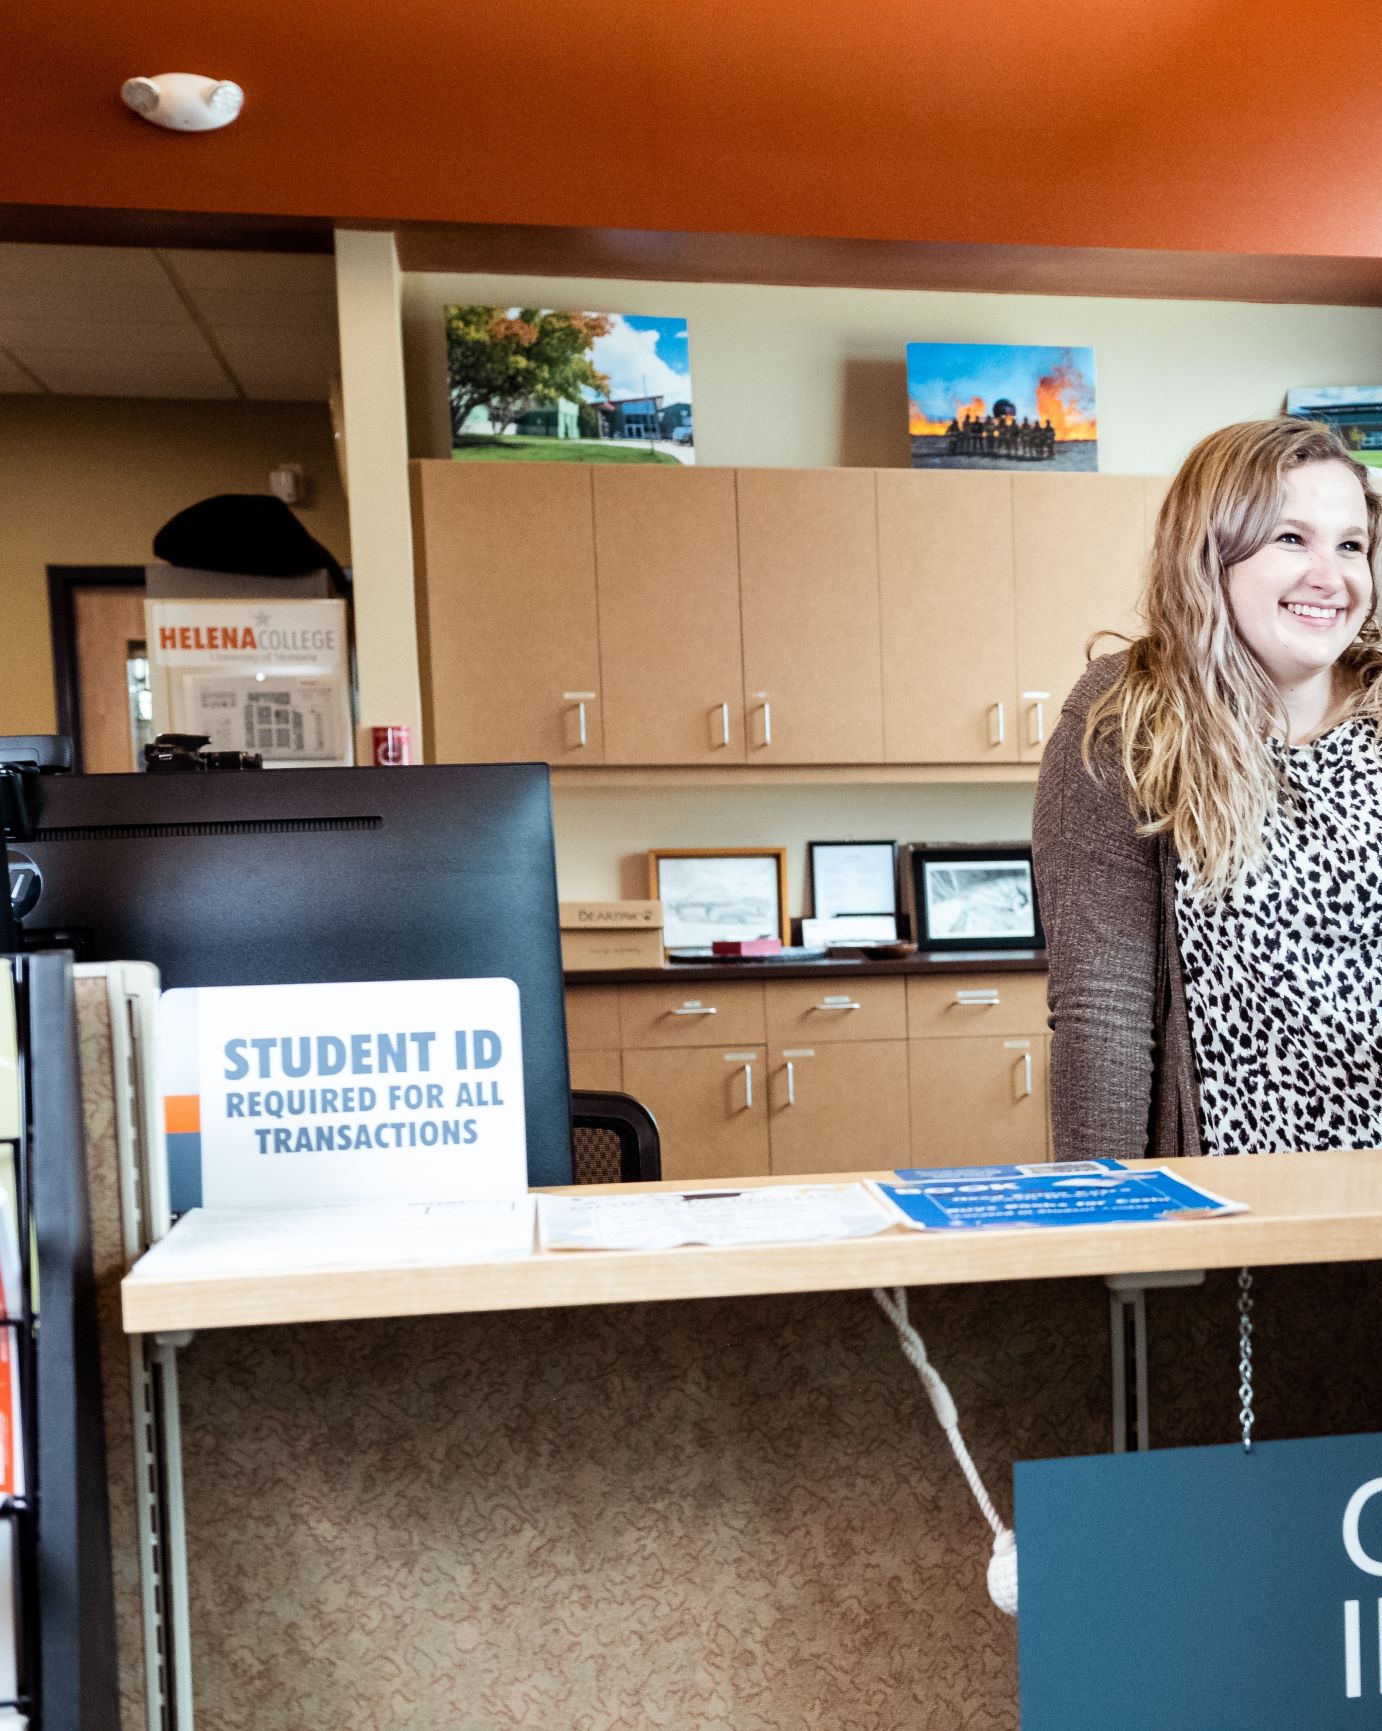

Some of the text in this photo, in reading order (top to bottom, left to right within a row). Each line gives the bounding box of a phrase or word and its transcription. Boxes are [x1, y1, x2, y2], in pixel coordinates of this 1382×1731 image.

[159, 626, 336, 651] HELENA COLLEGE
[224, 1030, 502, 1081] STUDENT ID
[226, 1081, 504, 1118] REQUIRED FOR ALL
[255, 1119, 478, 1155] TRANSACTIONS
